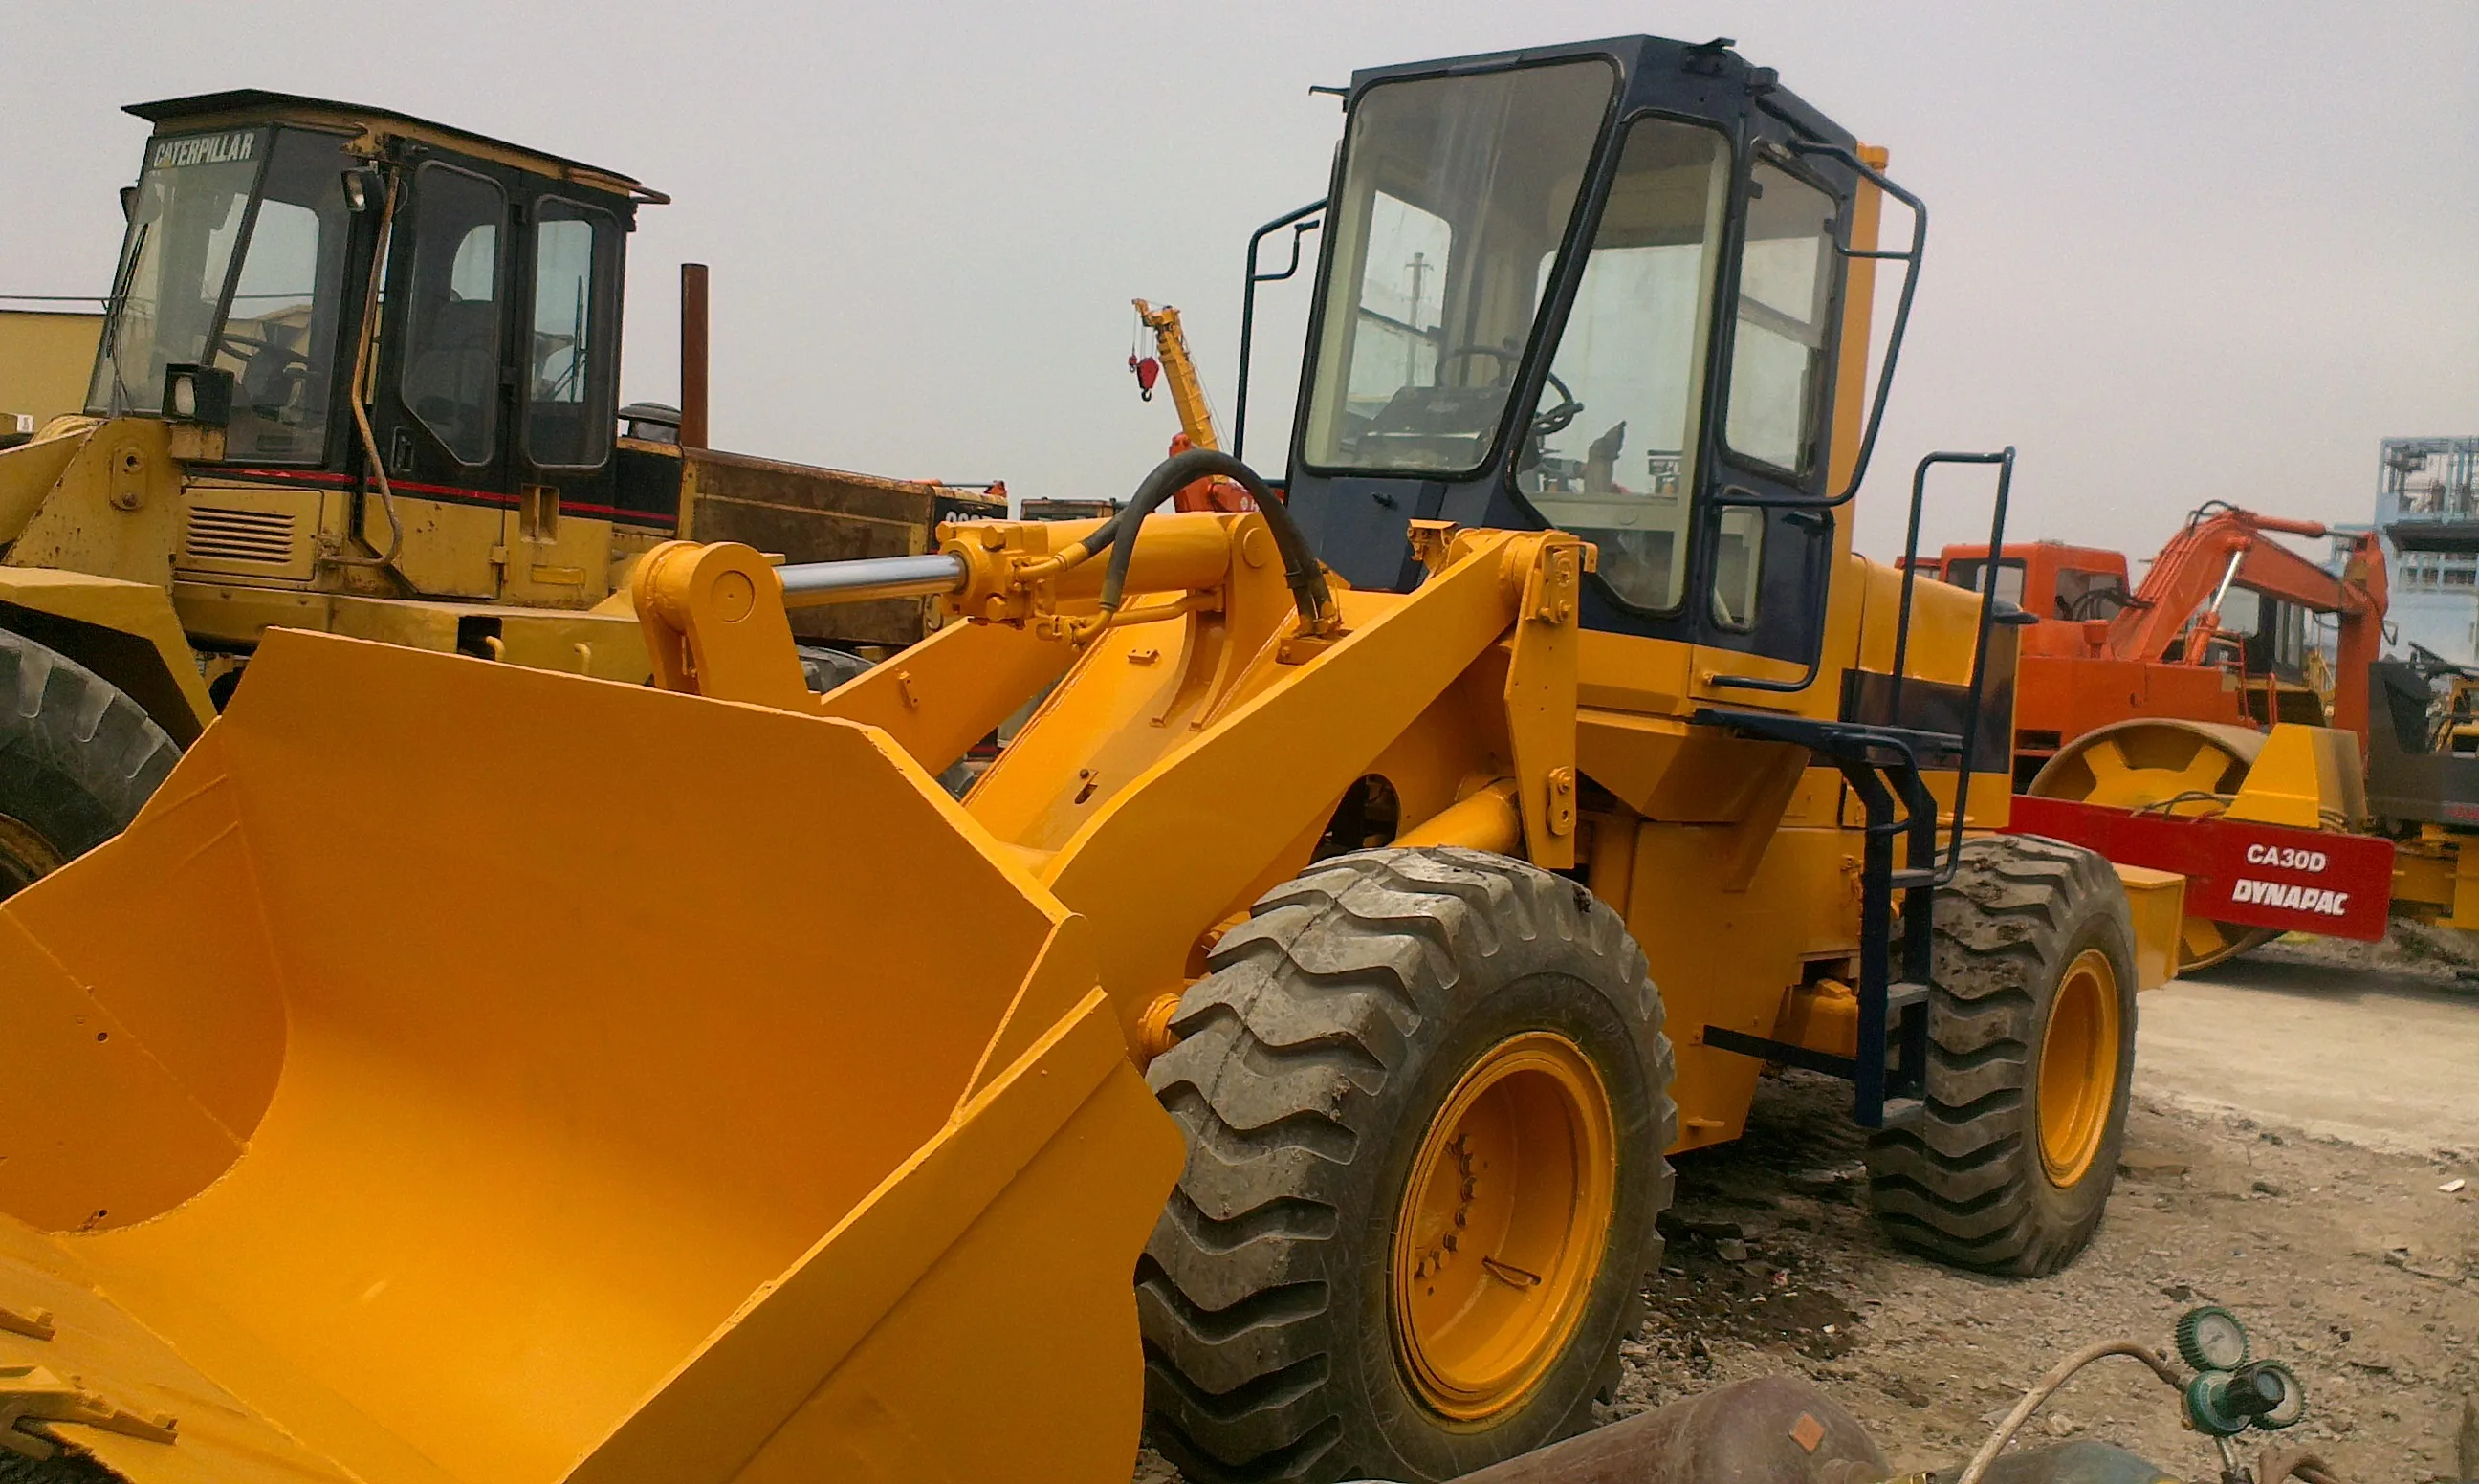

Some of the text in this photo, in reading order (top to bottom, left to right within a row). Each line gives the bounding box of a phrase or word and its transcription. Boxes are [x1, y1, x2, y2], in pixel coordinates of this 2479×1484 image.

[153, 133, 255, 168] CATERPILLAR
[2247, 843, 2327, 872] CA30D
[2231, 878, 2349, 916] DYNAPAC
